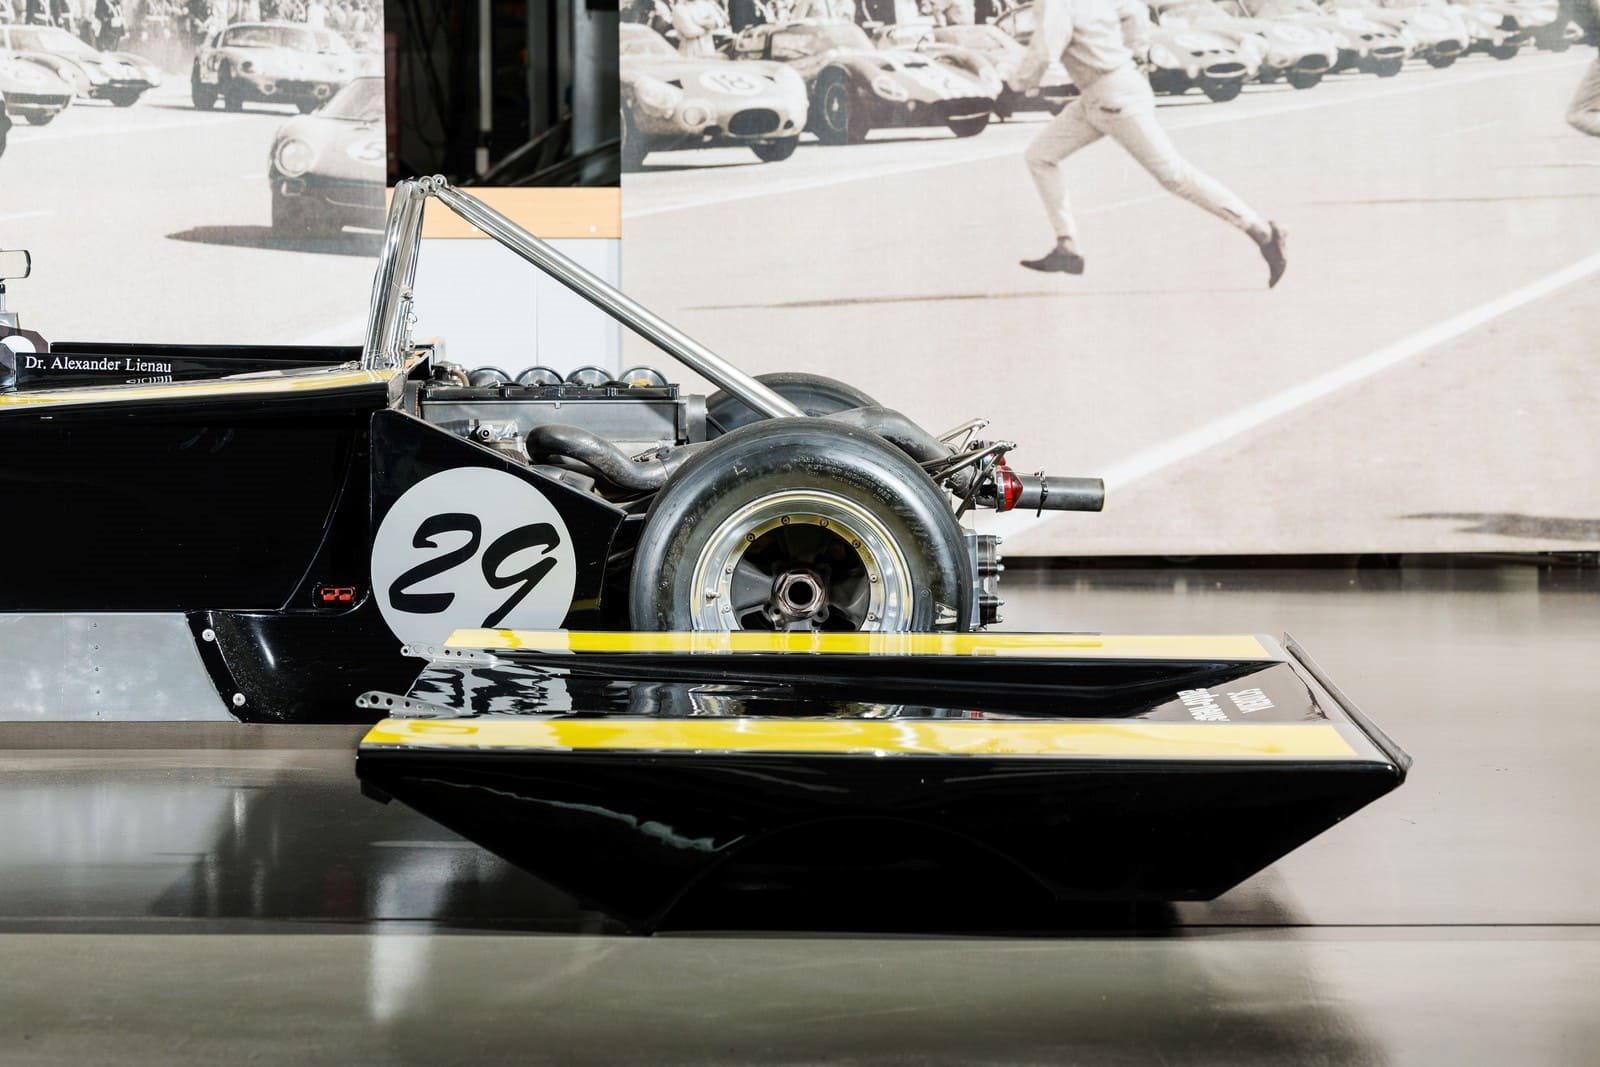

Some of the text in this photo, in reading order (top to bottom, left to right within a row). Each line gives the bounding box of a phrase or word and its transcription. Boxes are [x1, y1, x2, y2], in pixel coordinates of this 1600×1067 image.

[25, 356, 172, 373] Dr. Alexander Lienau
[388, 513, 561, 628] 29
